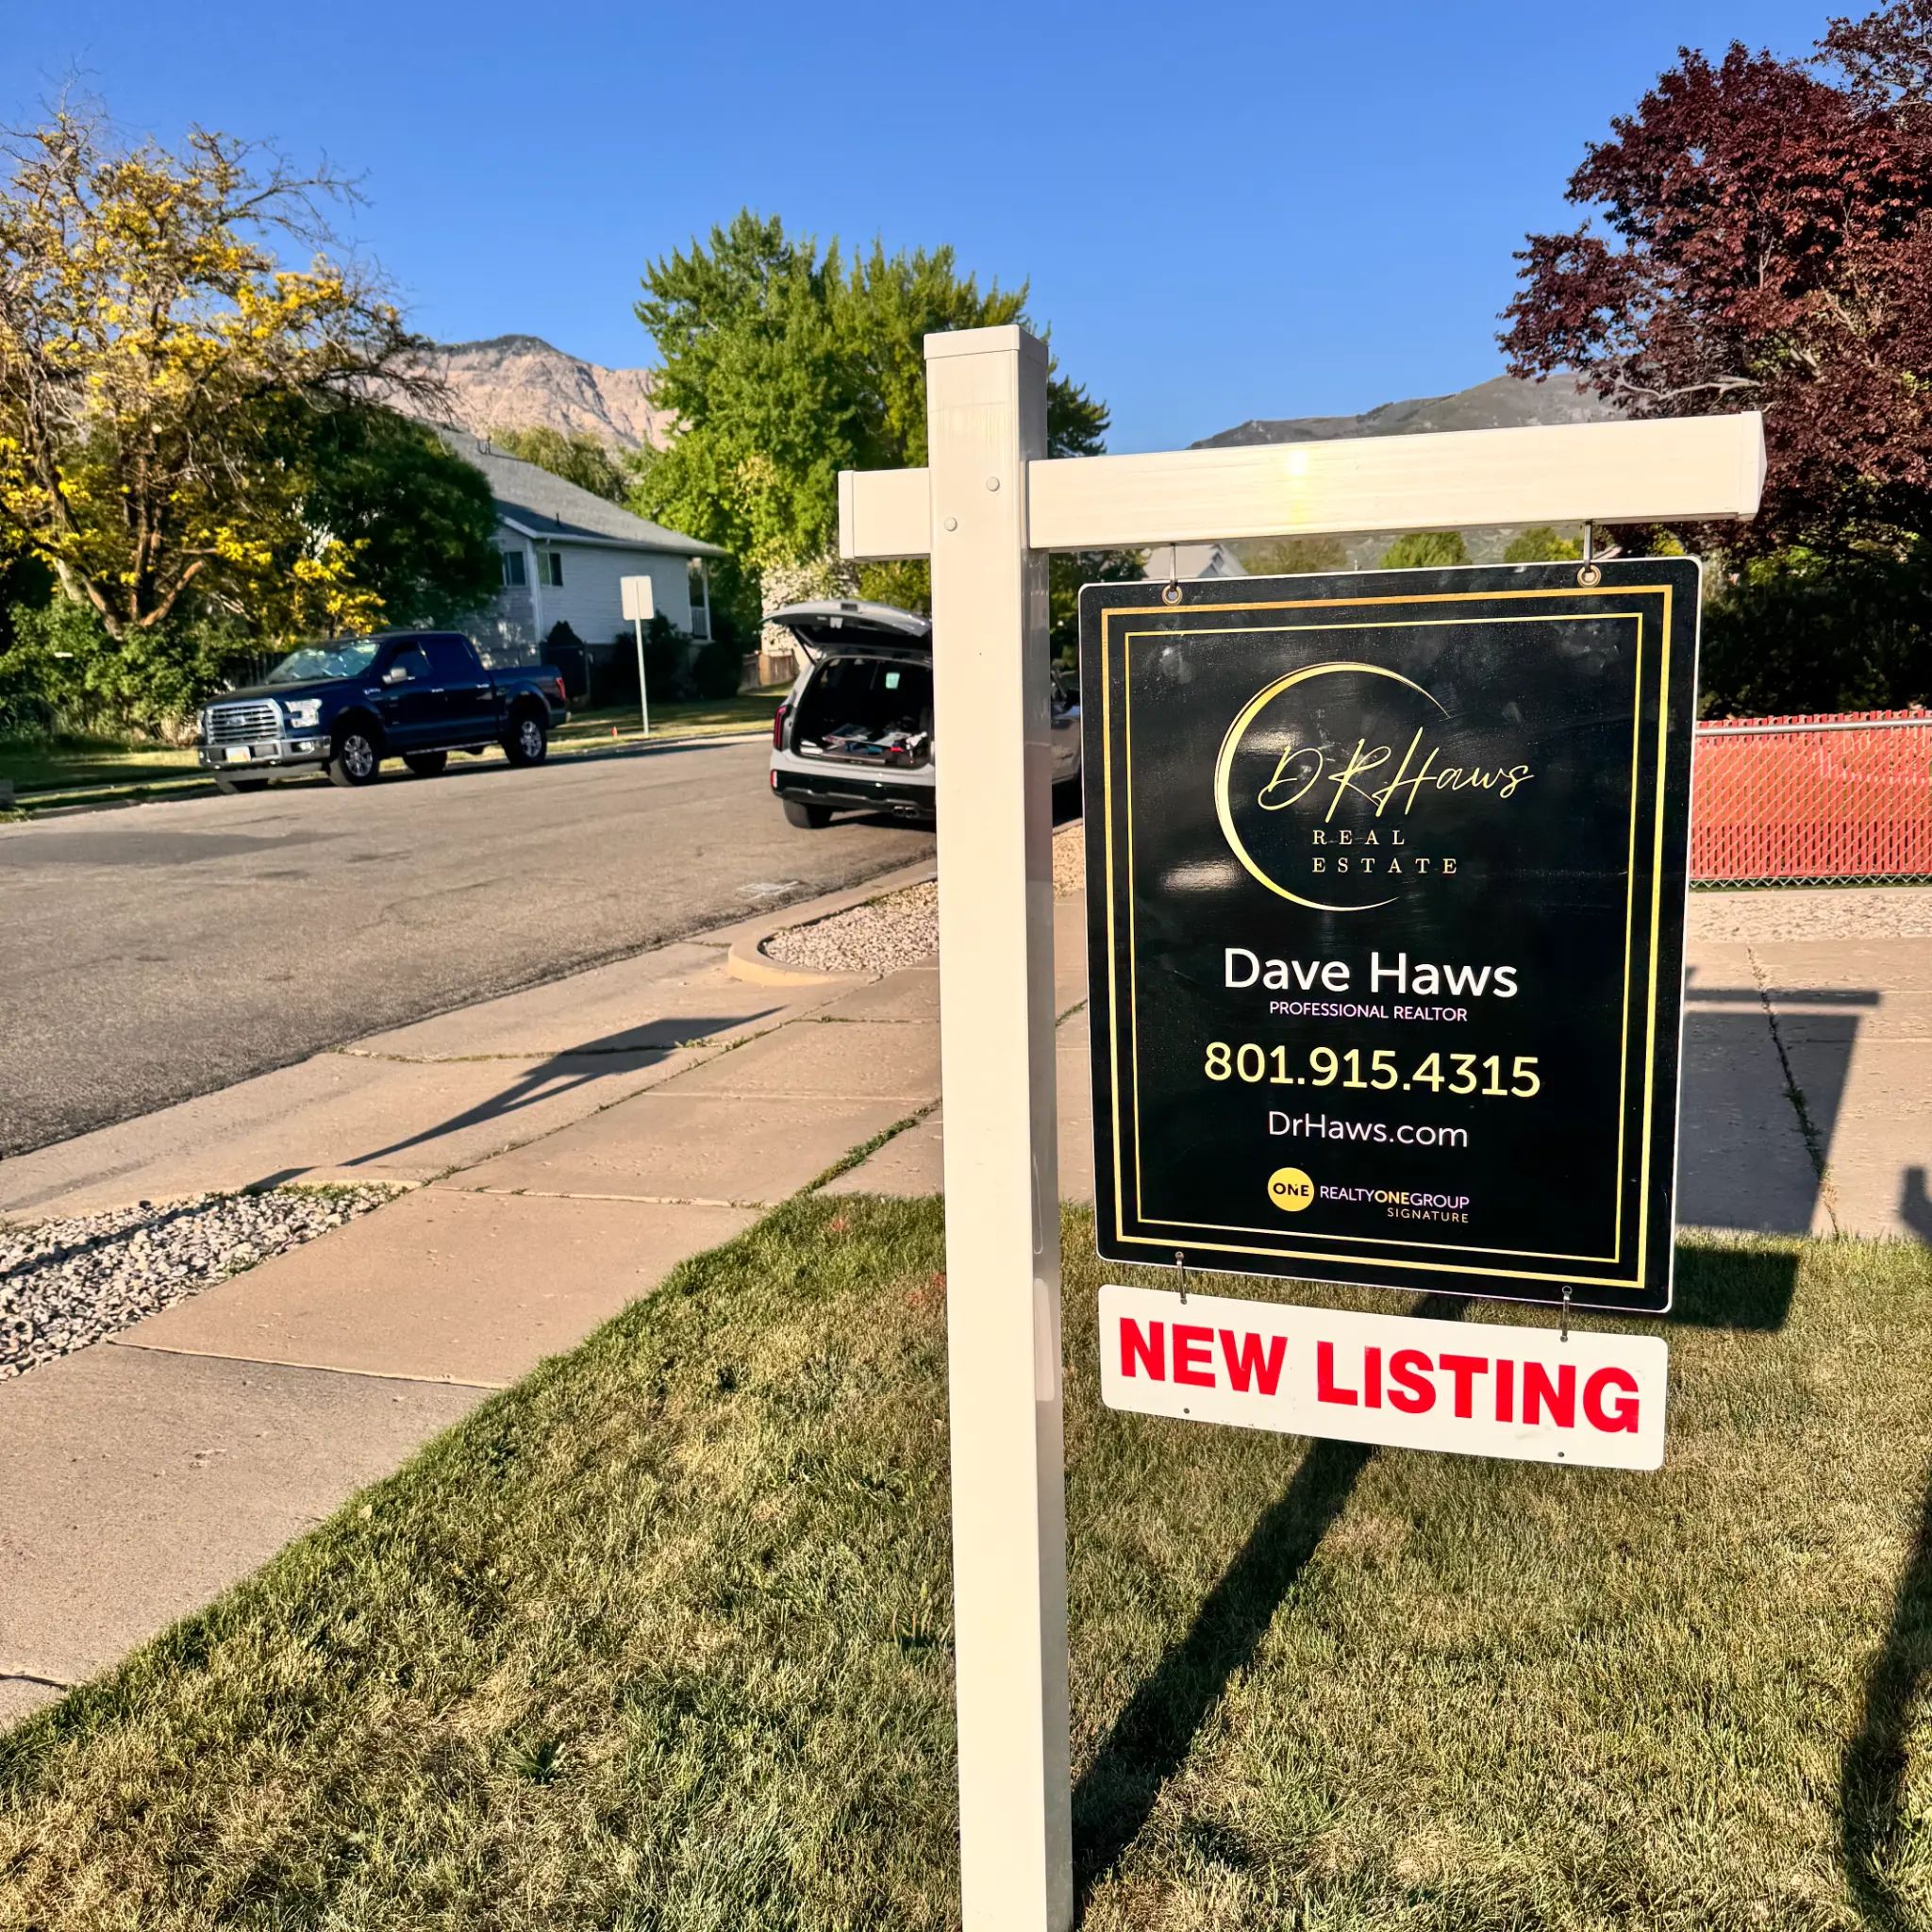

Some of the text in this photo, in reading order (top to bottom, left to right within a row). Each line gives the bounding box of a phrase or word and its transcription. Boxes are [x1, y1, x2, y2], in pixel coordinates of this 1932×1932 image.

[1312, 829, 1406, 845] REAL
[1311, 857, 1457, 874] ESTATE
[1224, 947, 1518, 998] Dave Haws
[1270, 1000, 1468, 1022] PROFESSIONAL REALTOR
[1204, 1041, 1541, 1098] 801.915.4315
[1269, 1110, 1468, 1148] DrHaws.com
[1273, 1182, 1310, 1197] ONE
[1387, 1207, 1469, 1224] SIGNATURE
[1119, 1316, 1641, 1434] NEW LISTING
